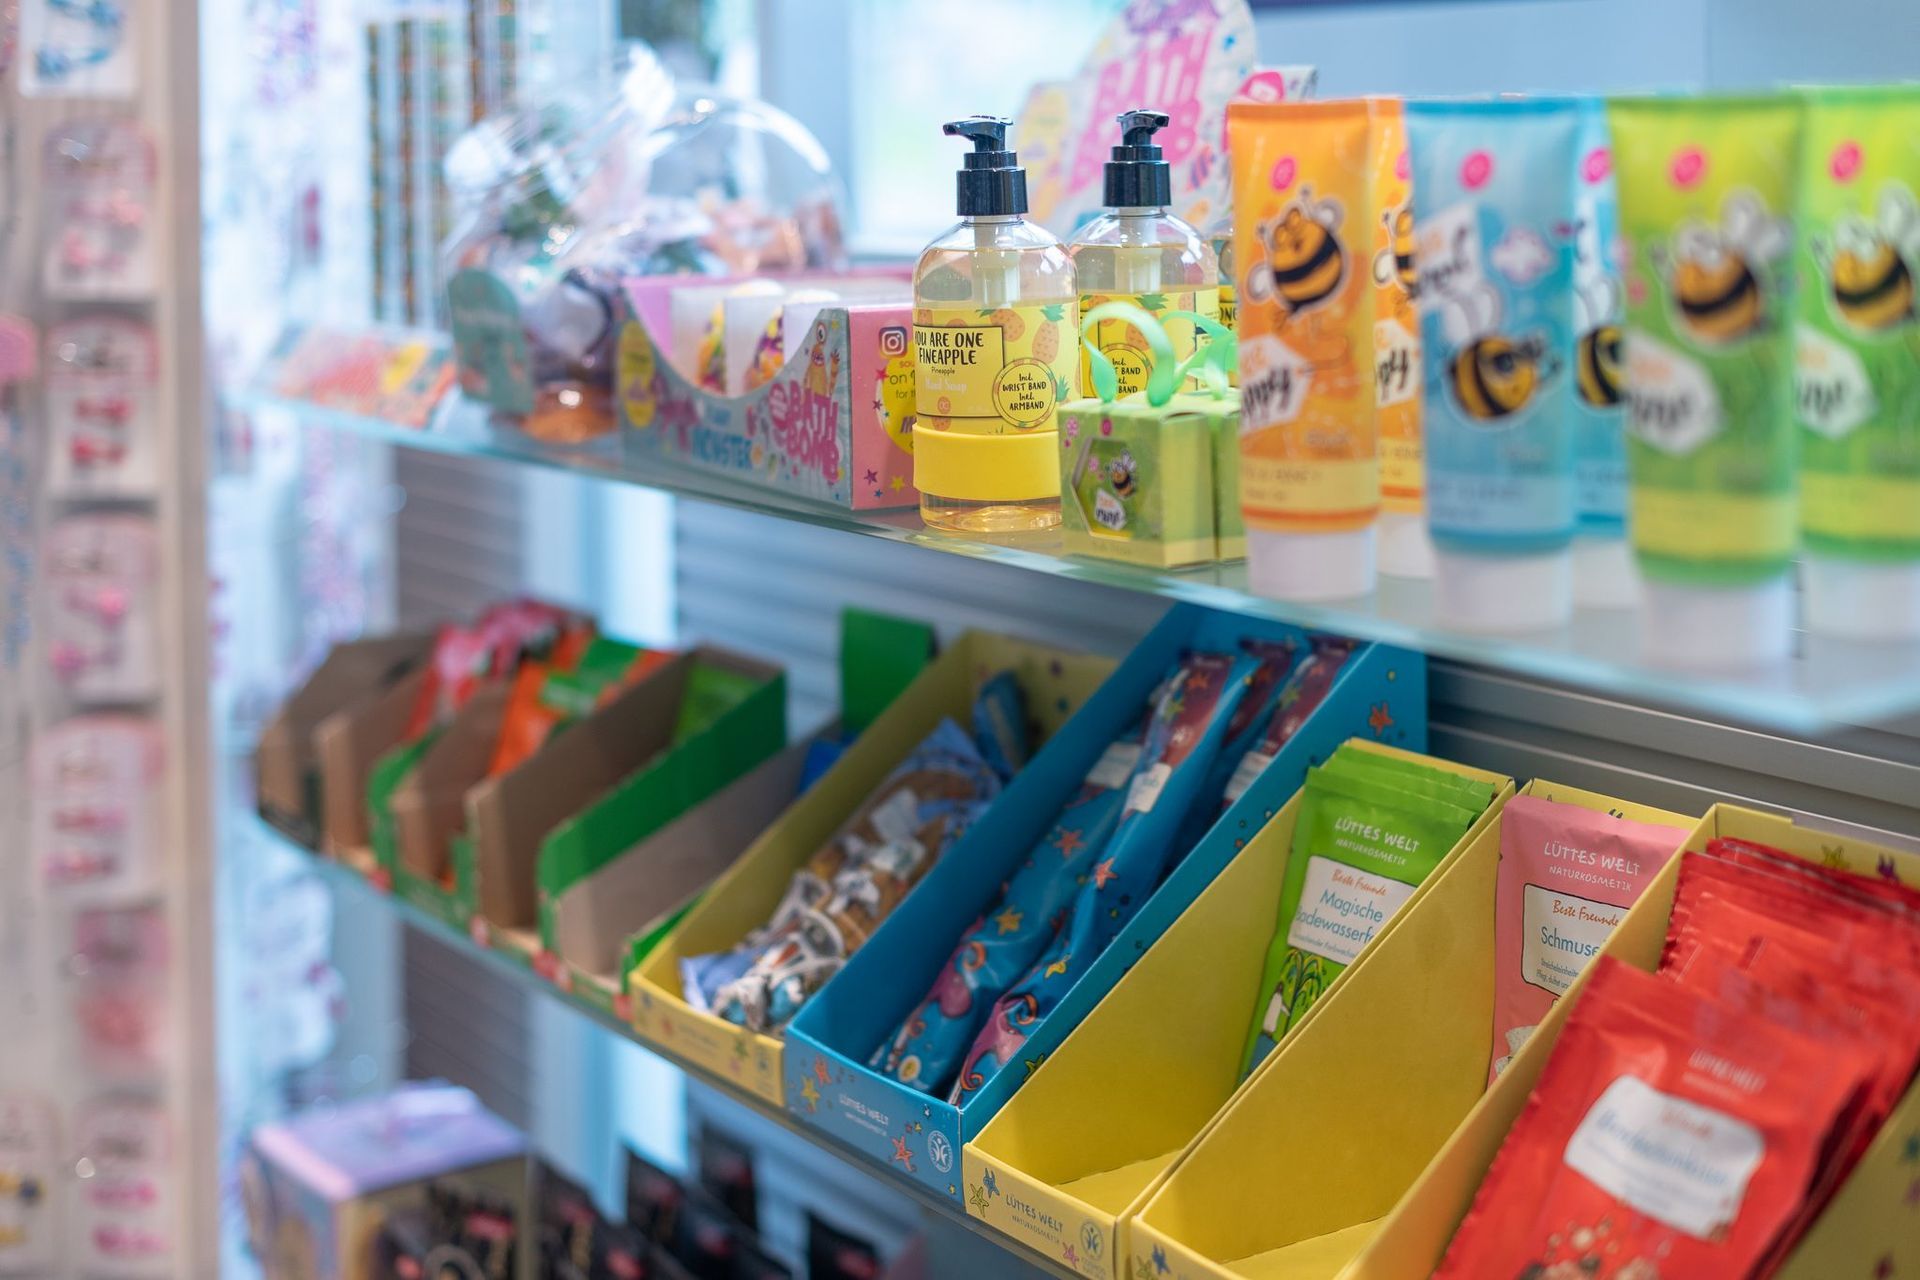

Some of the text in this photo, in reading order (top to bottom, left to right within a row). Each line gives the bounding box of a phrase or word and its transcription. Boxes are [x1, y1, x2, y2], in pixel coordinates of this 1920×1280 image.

[930, 331, 950, 348] ARE
[955, 331, 984, 348] ONE
[919, 347, 977, 366] FINEAPPLE
[890, 374, 907, 385] on
[931, 366, 955, 376] Pineapple
[1019, 373, 1034, 382] Incl.
[1121, 367, 1141, 376] BAND
[1003, 381, 1047, 393] WRIST BAND
[1019, 391, 1035, 402] Inkl.
[1118, 385, 1138, 395] BAND
[790, 379, 839, 442] BATH
[1009, 400, 1044, 412] ARMBAND
[786, 420, 840, 483] BOMB
[1335, 816, 1420, 854] LÜTTES WELT
[1336, 838, 1407, 867] NATURKOSMETIK
[1544, 840, 1641, 877] LÜTTES WELT
[1549, 865, 1632, 893] NATURKOSMETIK
[1320, 889, 1383, 923] Magische
[1552, 899, 1620, 927] Beste Freunde
[868, 1106, 889, 1126] WELT
[1006, 1193, 1063, 1234] LÜTTES WELT
